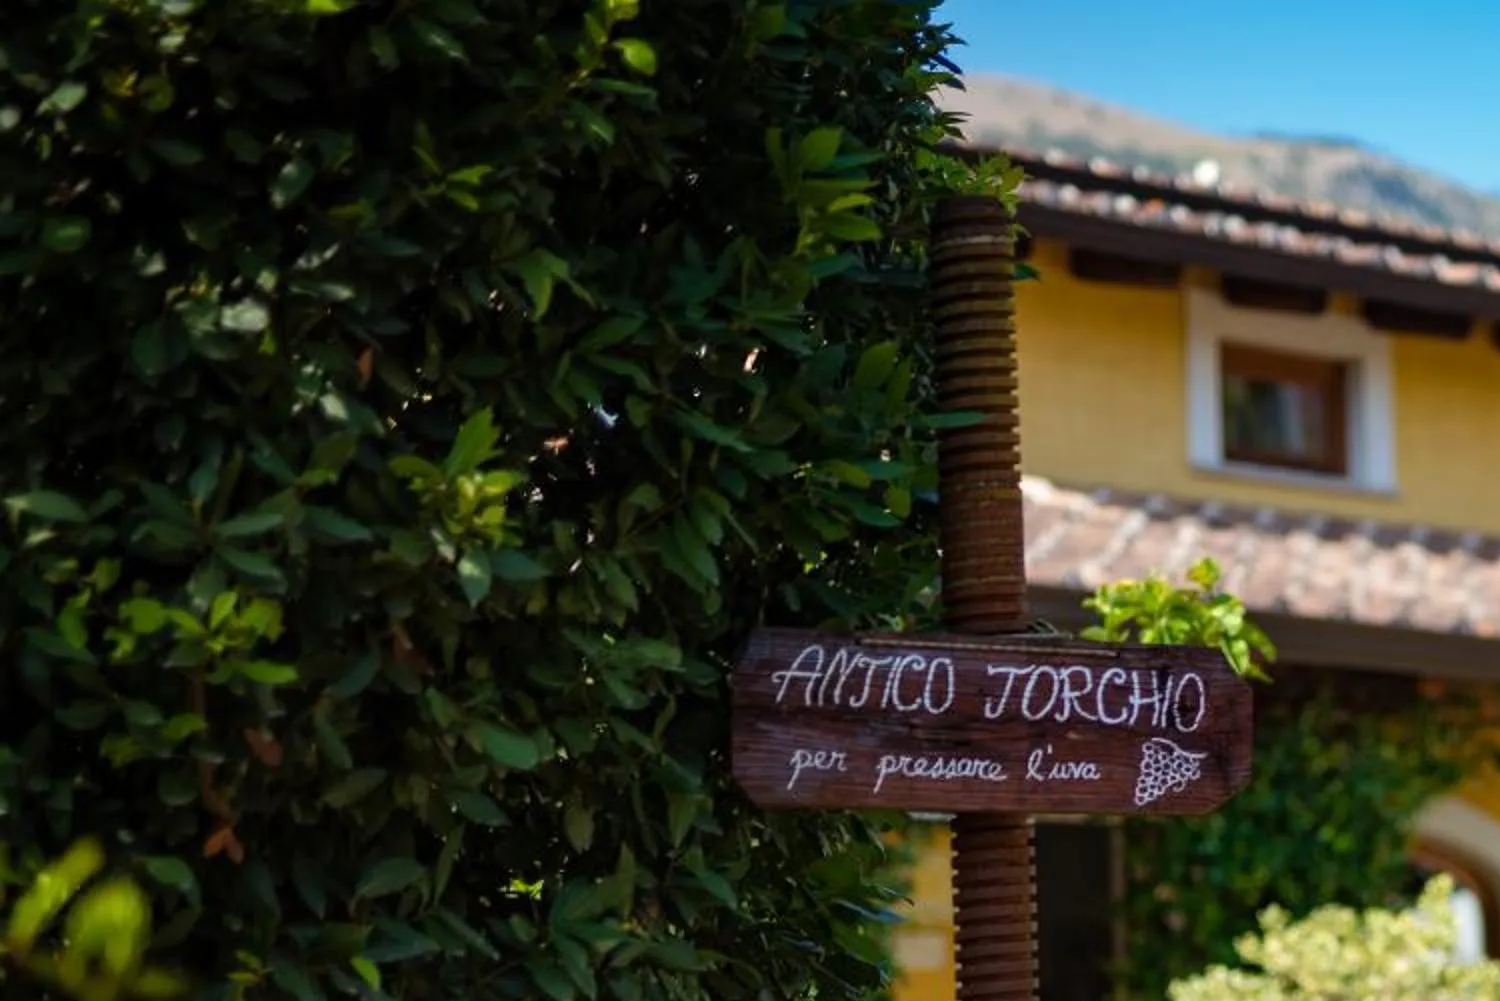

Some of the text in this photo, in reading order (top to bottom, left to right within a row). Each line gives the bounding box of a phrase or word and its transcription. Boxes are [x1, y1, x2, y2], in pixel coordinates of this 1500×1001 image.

[772, 644, 1206, 733] ANTICO TORCHIO
[787, 744, 1102, 794] per pressare l'uva
